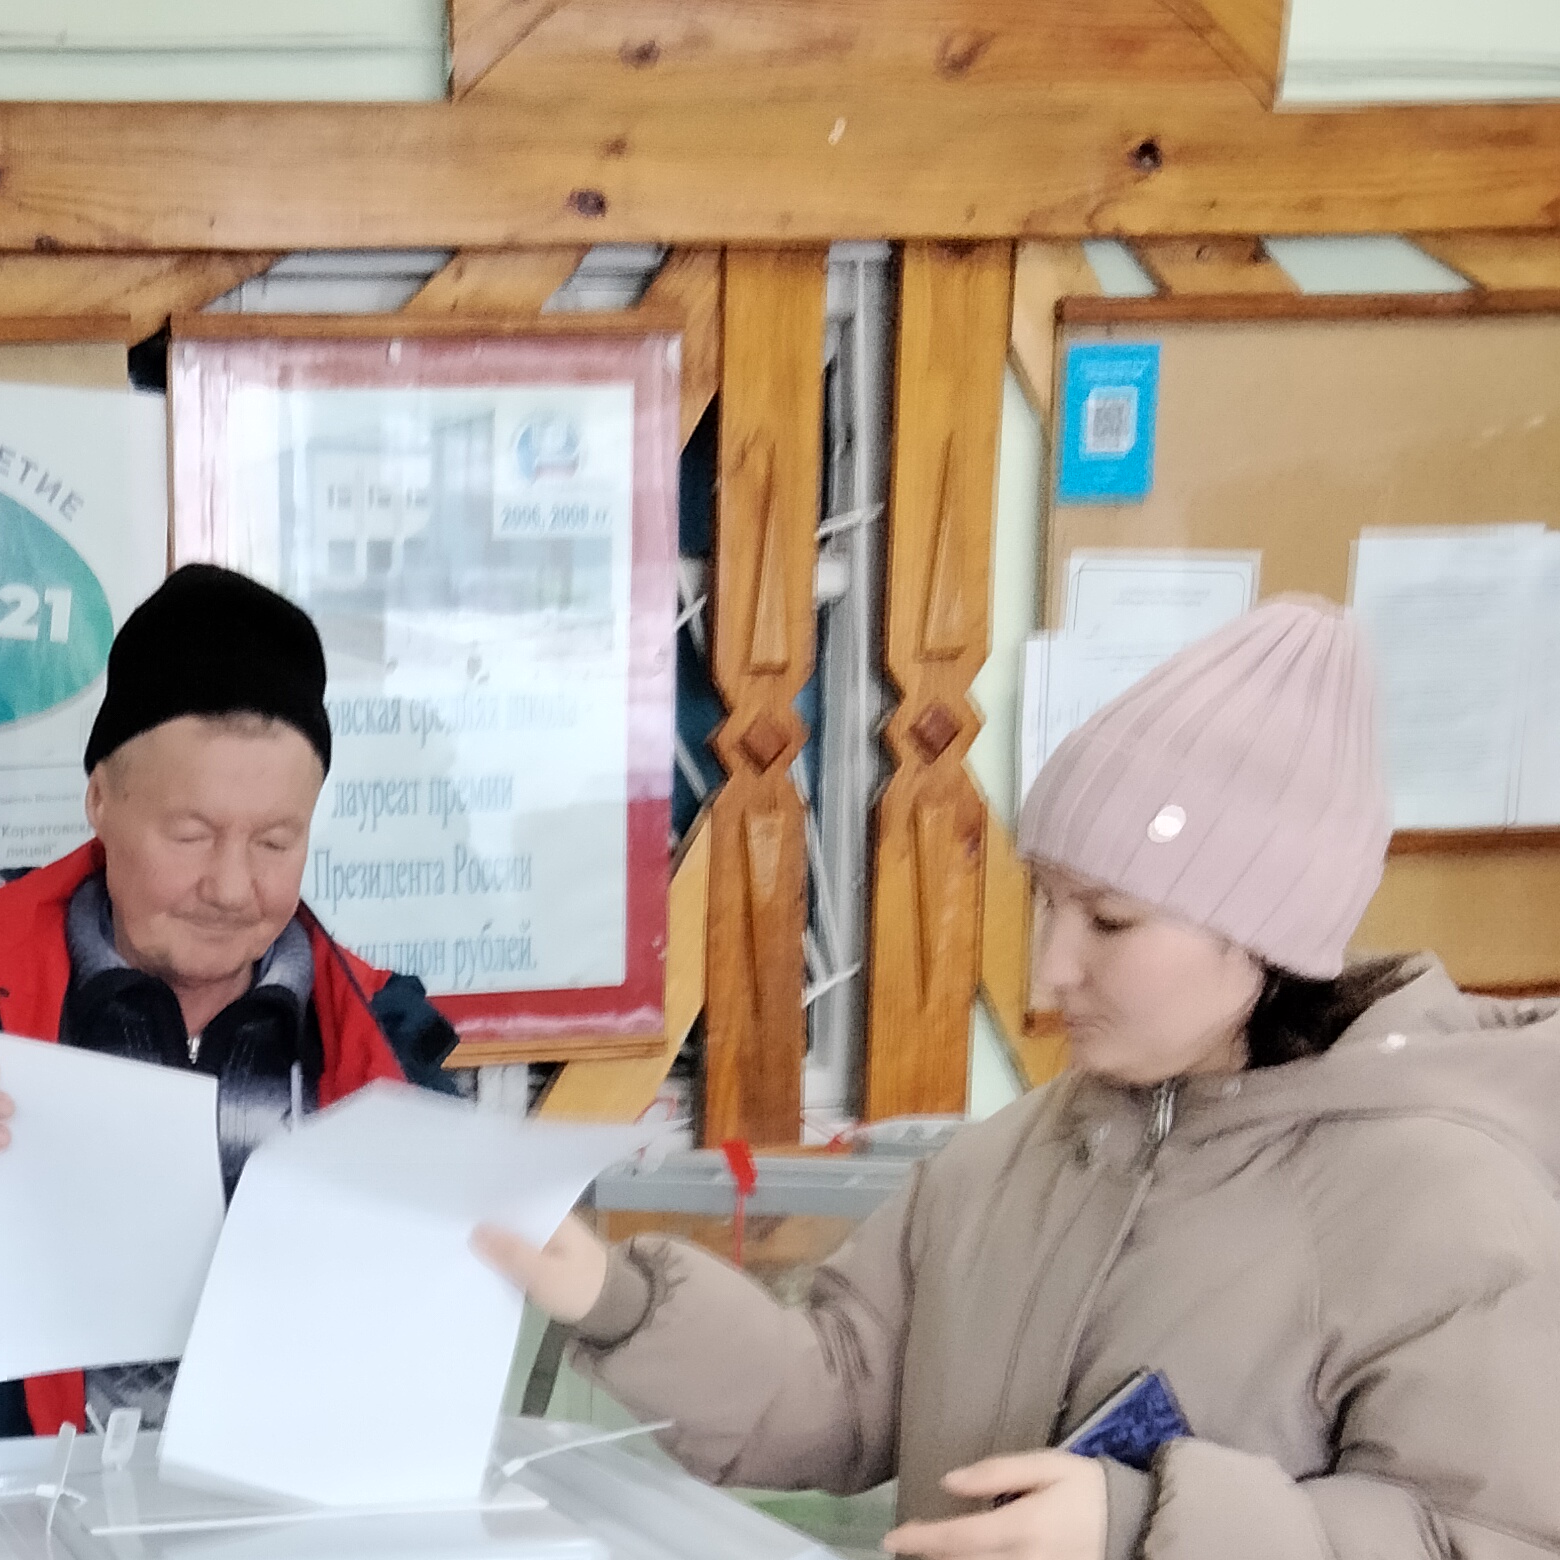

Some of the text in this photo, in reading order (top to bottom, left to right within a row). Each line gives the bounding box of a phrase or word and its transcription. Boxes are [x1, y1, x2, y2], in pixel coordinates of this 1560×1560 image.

[331, 772, 421, 833] лауреат
[314, 843, 533, 915] Президента России
[354, 918, 538, 990] иллион рублей.
